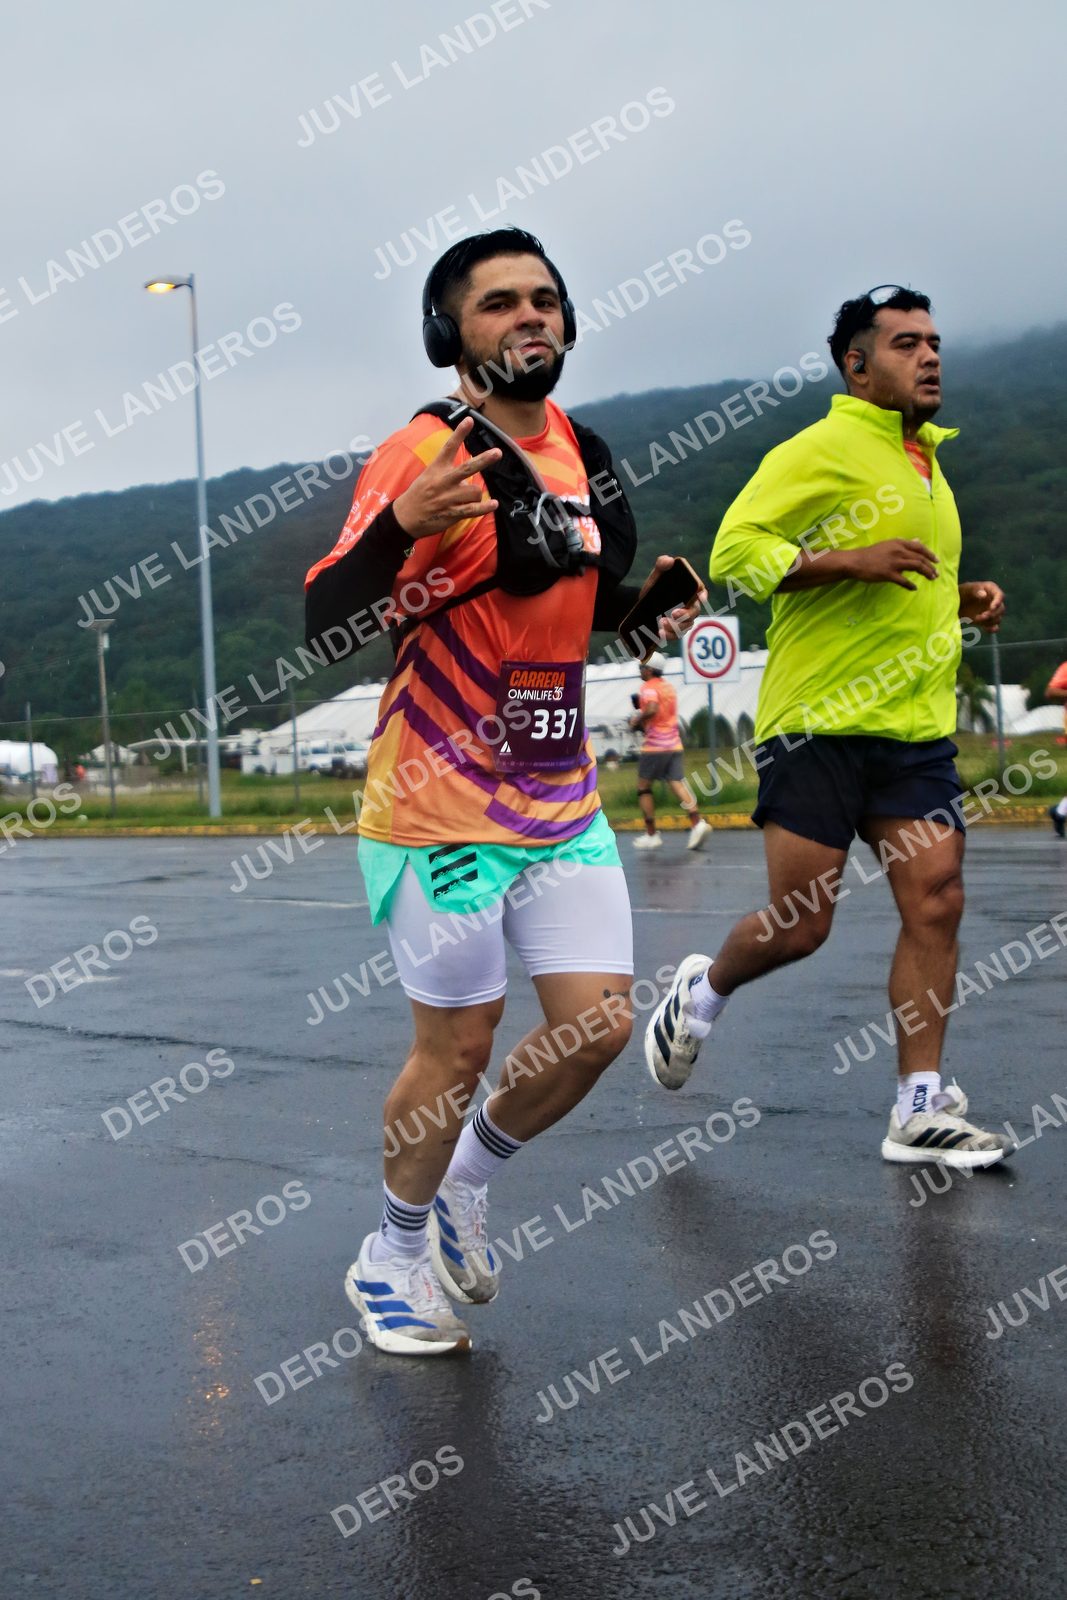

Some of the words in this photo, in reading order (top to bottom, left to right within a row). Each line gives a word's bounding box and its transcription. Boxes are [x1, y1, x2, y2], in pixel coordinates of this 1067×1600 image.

[695, 635, 727, 660] 30
[509, 670, 566, 688] CARRERA
[508, 688, 553, 701] OMNILIFE
[530, 707, 578, 740] 337
